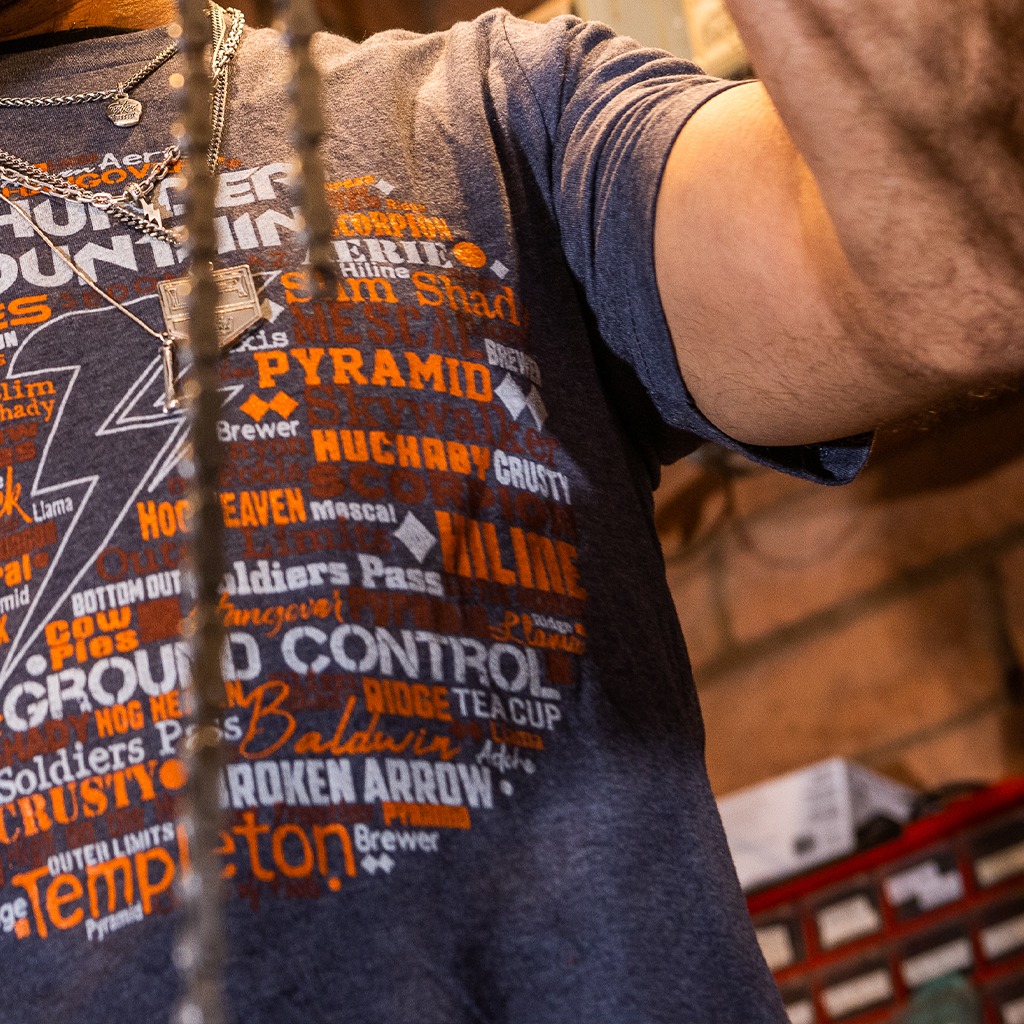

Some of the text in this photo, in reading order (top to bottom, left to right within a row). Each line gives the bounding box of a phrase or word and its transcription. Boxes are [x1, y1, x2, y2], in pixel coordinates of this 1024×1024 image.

[304, 237, 454, 269] ERIE
[340, 261, 411, 280] Hiline
[411, 270, 522, 327] Shad
[228, 329, 290, 354] xis
[253, 347, 493, 403] PYRAMID
[216, 419, 301, 443] Brewer
[493, 448, 572, 506] CRUSTY
[32, 496, 74, 523] Llama
[219, 487, 308, 529] EAVEN
[72, 569, 182, 618] BOTTOM OUT
[216, 558, 350, 597] ldiers
[357, 552, 446, 599] Pass
[43, 604, 133, 647] Cow
[49, 628, 140, 672] Pies
[280, 623, 563, 702] CONTROL
[94, 699, 145, 739] HOG
[238, 679, 462, 761] Baldwin
[362, 676, 453, 722] RIDGE
[154, 715, 245, 757] Ps
[363, 757, 494, 810] ARROW
[47, 839, 110, 876] OUTER
[113, 822, 176, 861] LIMITS
[353, 823, 441, 854] Brewer
